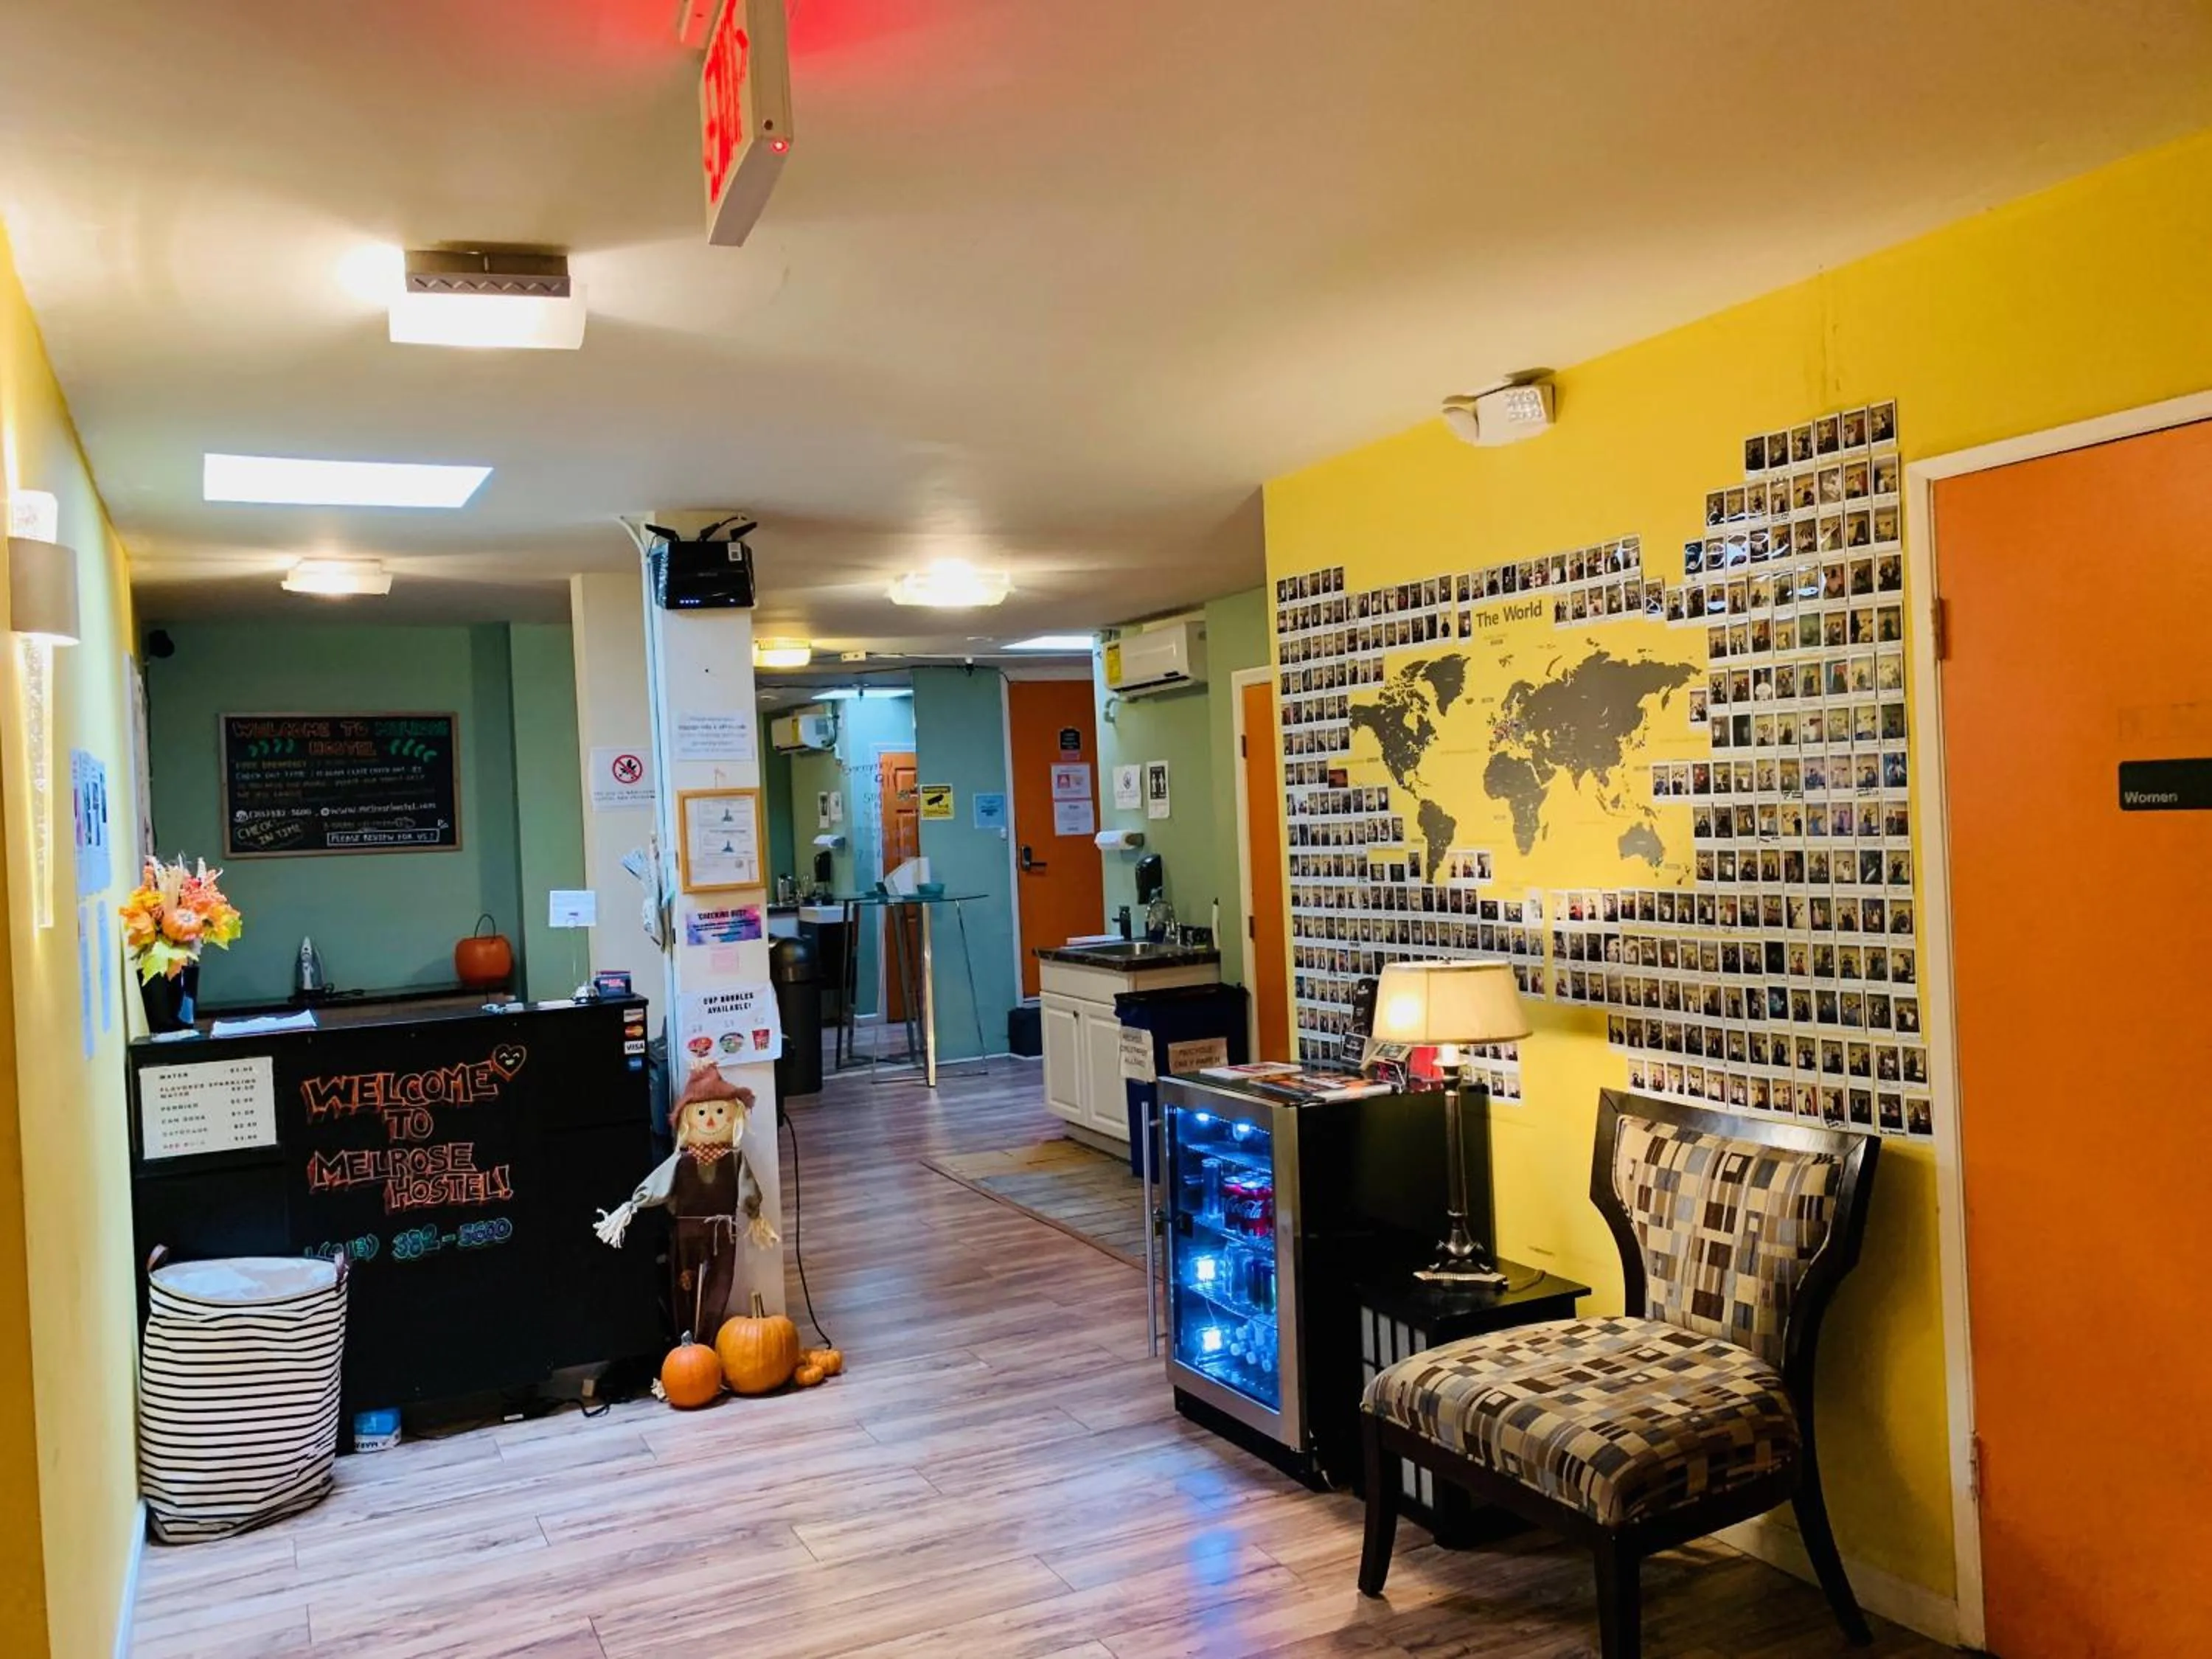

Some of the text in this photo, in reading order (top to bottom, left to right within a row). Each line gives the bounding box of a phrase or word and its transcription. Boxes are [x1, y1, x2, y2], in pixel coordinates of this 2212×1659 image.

[1475, 599, 1543, 627] The World
[2124, 791, 2178, 804] Women
[626, 1043, 644, 1051] VISA
[301, 1060, 499, 1119] WELCOME
[383, 1107, 434, 1141] TO
[308, 1142, 478, 1192] MELROSE
[384, 1164, 514, 1213] HOSTEL!
